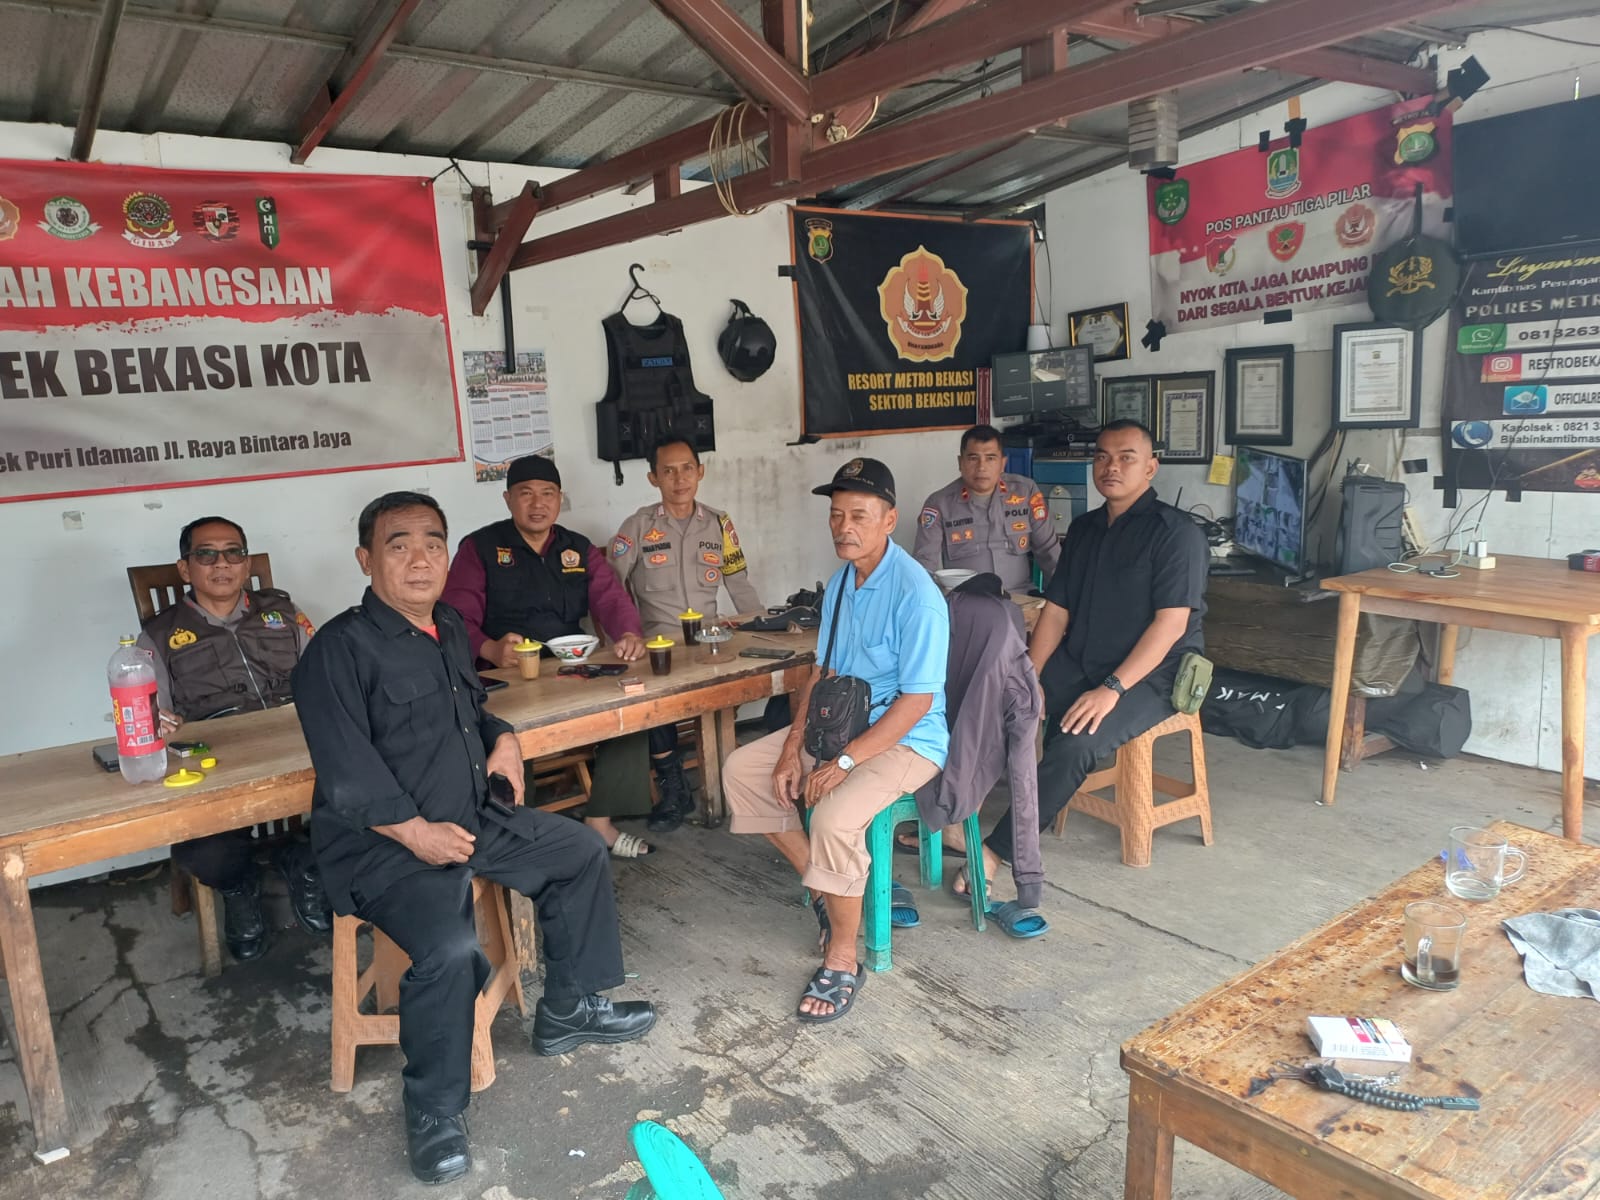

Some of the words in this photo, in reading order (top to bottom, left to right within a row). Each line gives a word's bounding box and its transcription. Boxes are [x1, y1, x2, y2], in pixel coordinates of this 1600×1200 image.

[1206, 218, 1232, 235] POS
[1235, 205, 1289, 229] PANTAU
[1292, 197, 1325, 216] TIGA
[1327, 183, 1372, 207] PILAR
[0, 267, 56, 307] AH
[63, 267, 333, 307] KEBANGSAAN
[1180, 286, 1217, 304] NYOK
[1219, 280, 1248, 298] KITA
[1250, 272, 1288, 292] JAGA
[1291, 255, 1368, 283] KAMPUNG
[1177, 305, 1207, 322] DARI
[1210, 296, 1264, 316] SEGALA
[1265, 284, 1325, 308] BENTUK
[1466, 299, 1543, 318] POLRES
[0, 350, 67, 399] EK
[74, 345, 252, 396] BEKASI
[260, 341, 371, 387] KOTA
[847, 373, 892, 391] RESORT
[894, 371, 934, 389] METRO
[935, 370, 974, 387] BEKASI
[869, 393, 913, 411] SEKTOR
[915, 391, 955, 409] BEKASI
[1501, 423, 1553, 433] Kapolsek
[1563, 422, 1589, 431] 0821
[25, 448, 73, 471] Puri
[76, 445, 160, 467] Idaman
[164, 441, 184, 460] Jl.
[187, 440, 236, 459] Raya
[240, 433, 310, 454] Bintara
[313, 431, 352, 449] Jaya
[699, 541, 722, 550] POLRI
